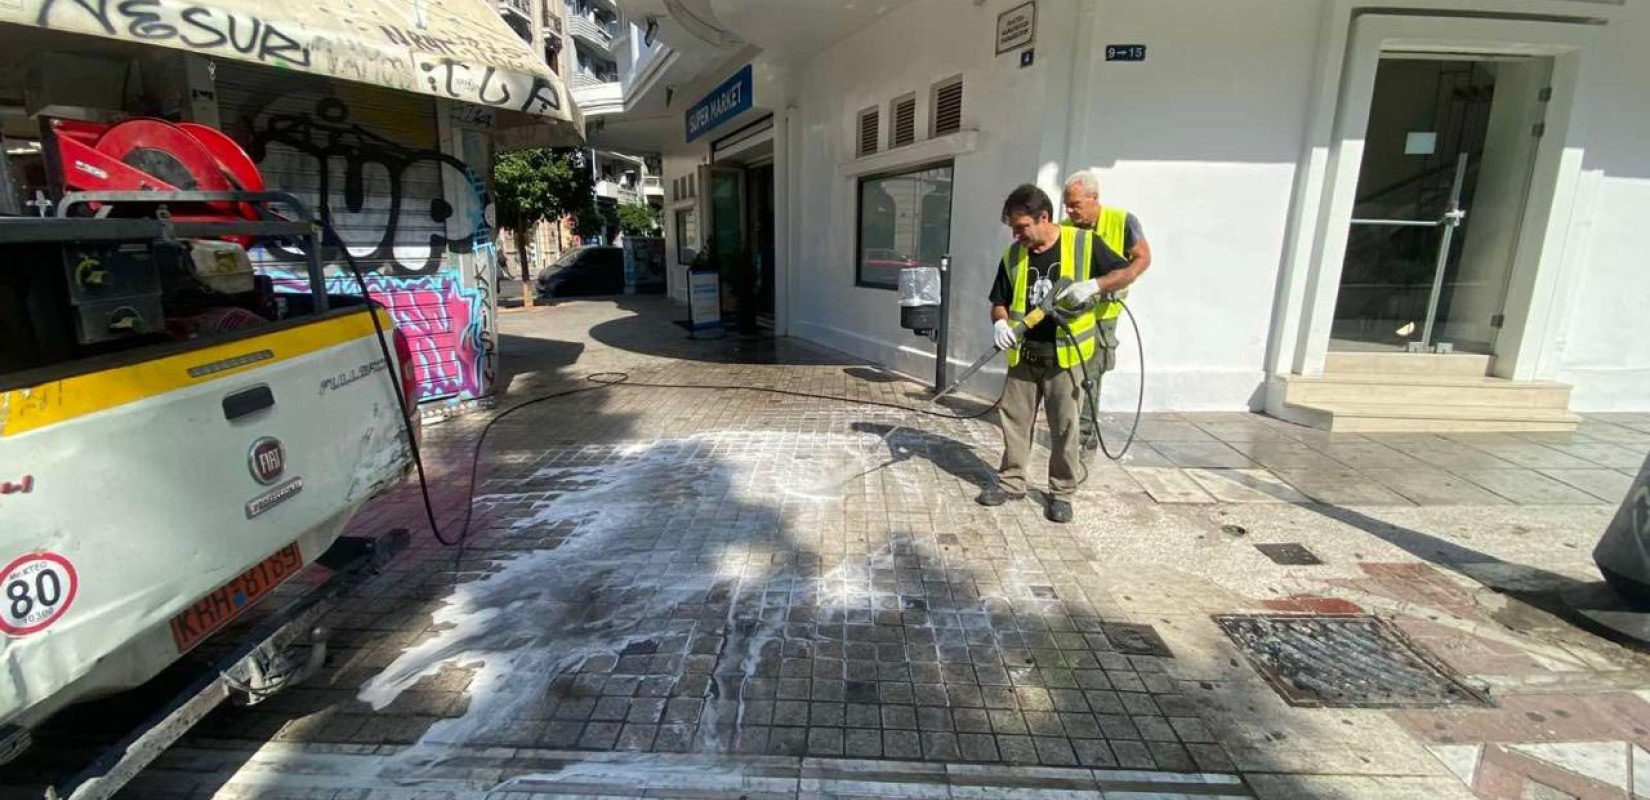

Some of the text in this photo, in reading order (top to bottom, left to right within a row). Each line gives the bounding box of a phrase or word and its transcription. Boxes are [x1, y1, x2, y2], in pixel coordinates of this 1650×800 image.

[1108, 47, 1143, 58] 9 15
[690, 80, 743, 134] SUPER MARKET
[259, 448, 281, 475] FIAT
[6, 568, 61, 619] 80
